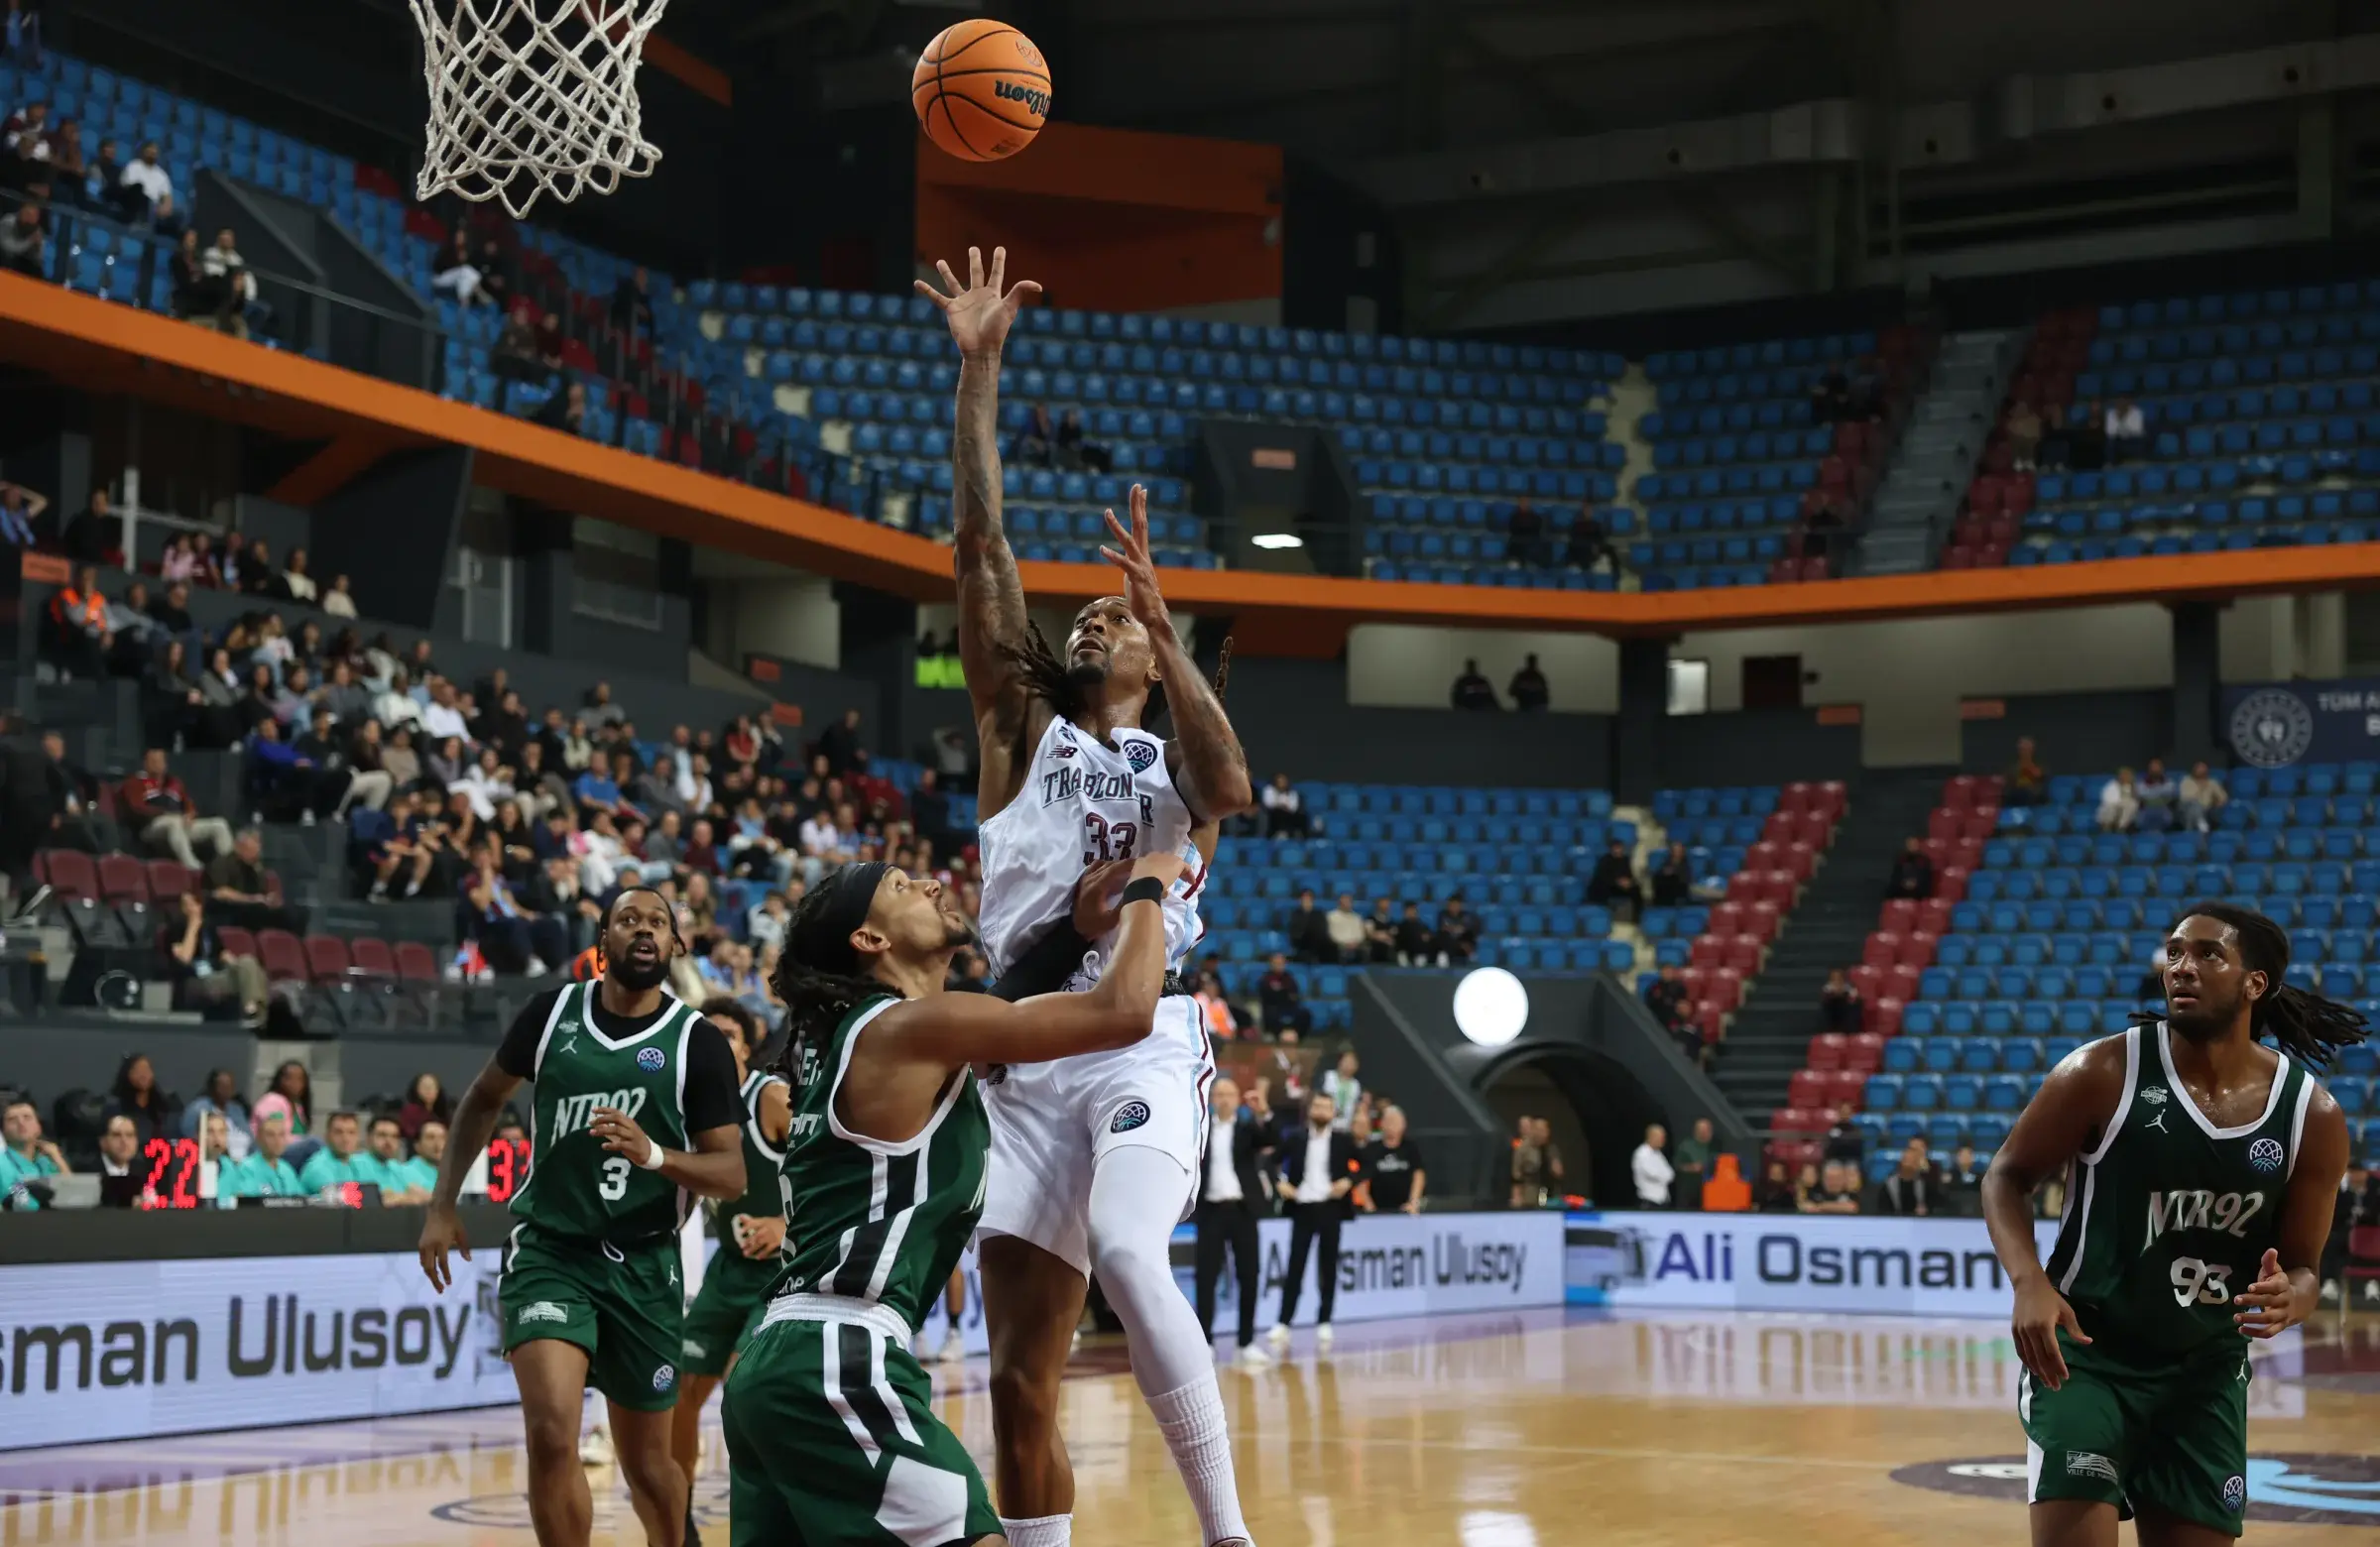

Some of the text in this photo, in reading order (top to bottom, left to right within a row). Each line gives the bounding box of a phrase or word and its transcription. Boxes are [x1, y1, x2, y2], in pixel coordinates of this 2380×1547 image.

[142, 1137, 199, 1210] 22
[599, 1156, 632, 1201] 3
[2139, 1190, 2264, 1257] NTR92
[1337, 1246, 1425, 1291] sman
[1434, 1232, 1527, 1293] Ulusoy
[1655, 1232, 1733, 1282] Ali
[1757, 1236, 2001, 1289] Osman
[228, 1294, 471, 1379] Ulusoy
